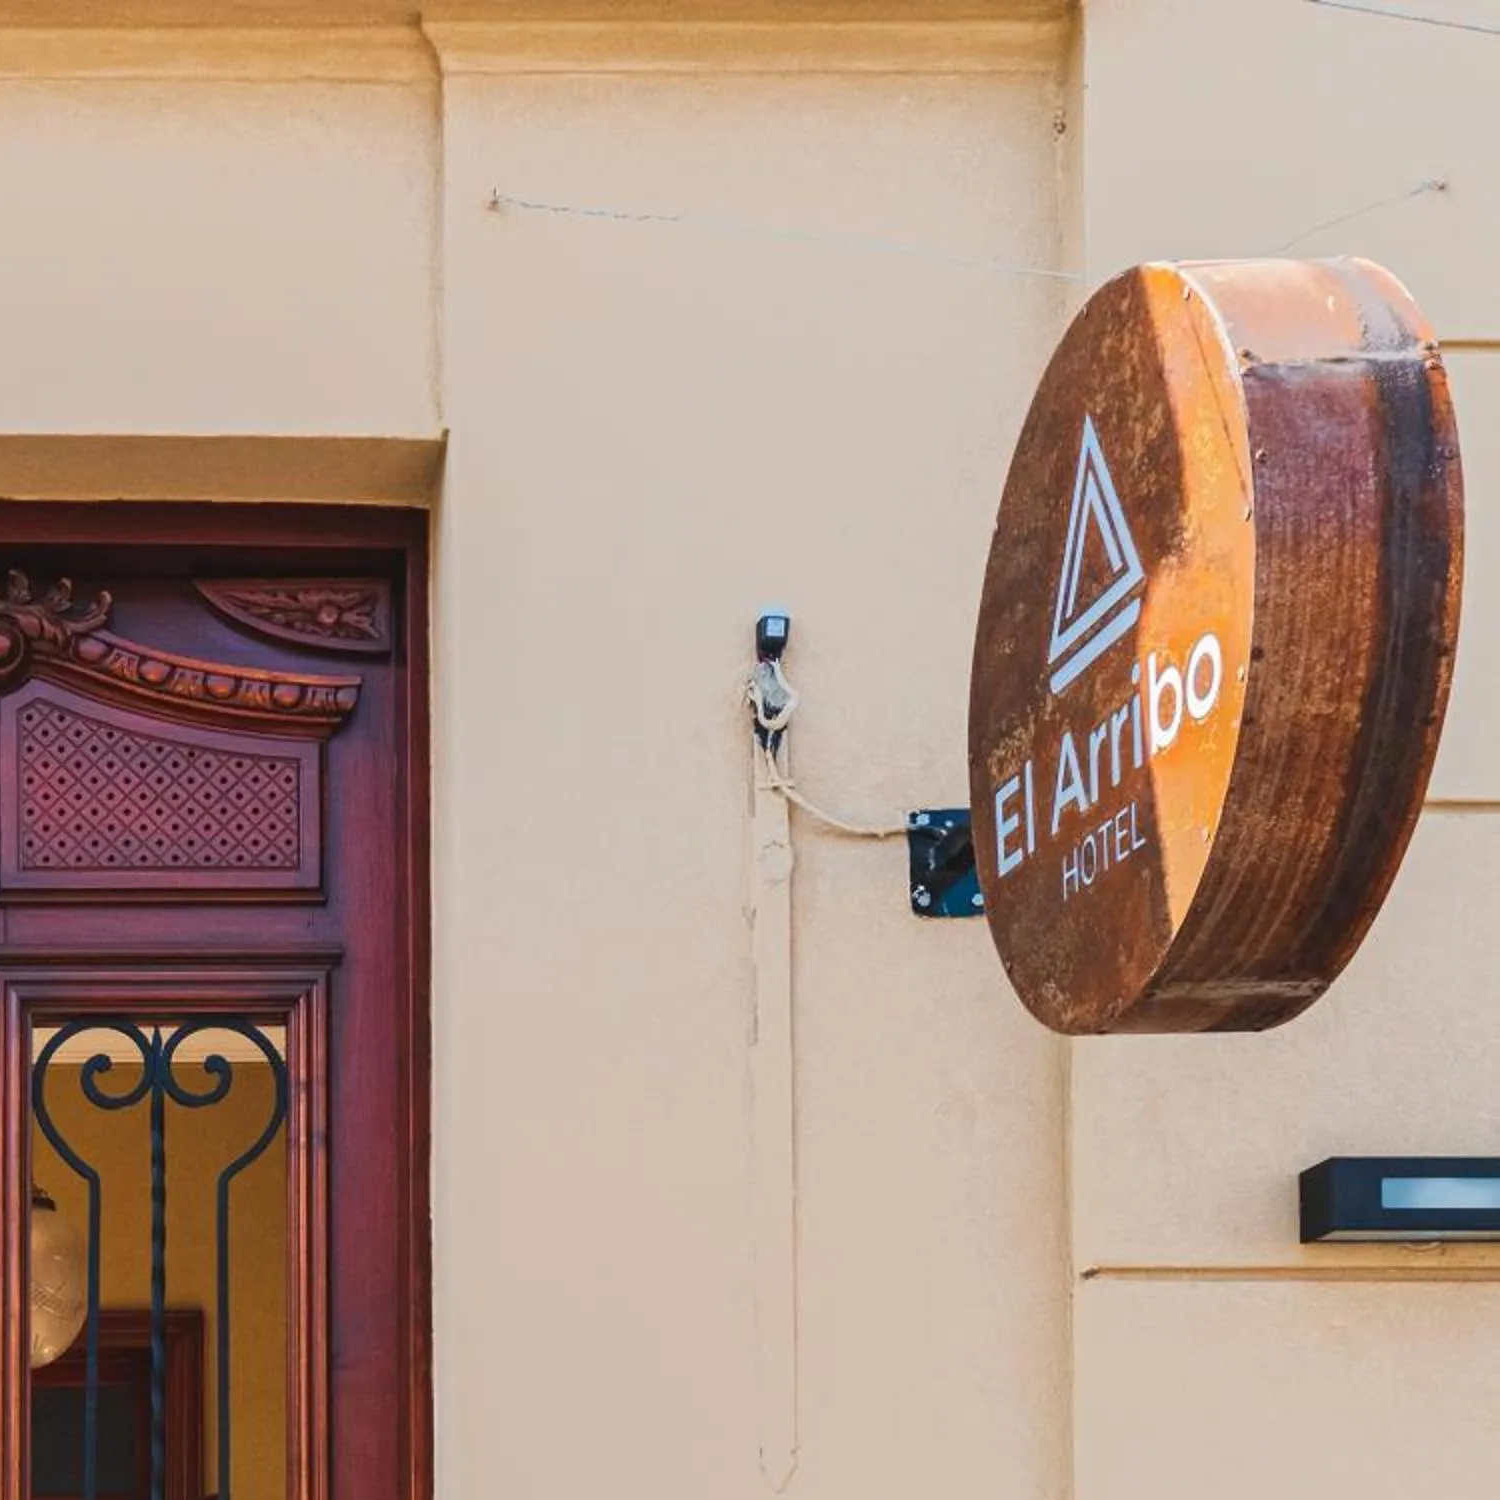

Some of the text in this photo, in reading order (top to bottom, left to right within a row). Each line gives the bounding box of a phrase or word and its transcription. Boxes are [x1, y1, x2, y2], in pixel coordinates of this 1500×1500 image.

[994, 633, 1222, 878] El Arribo
[1062, 801, 1147, 902] HOTEL
